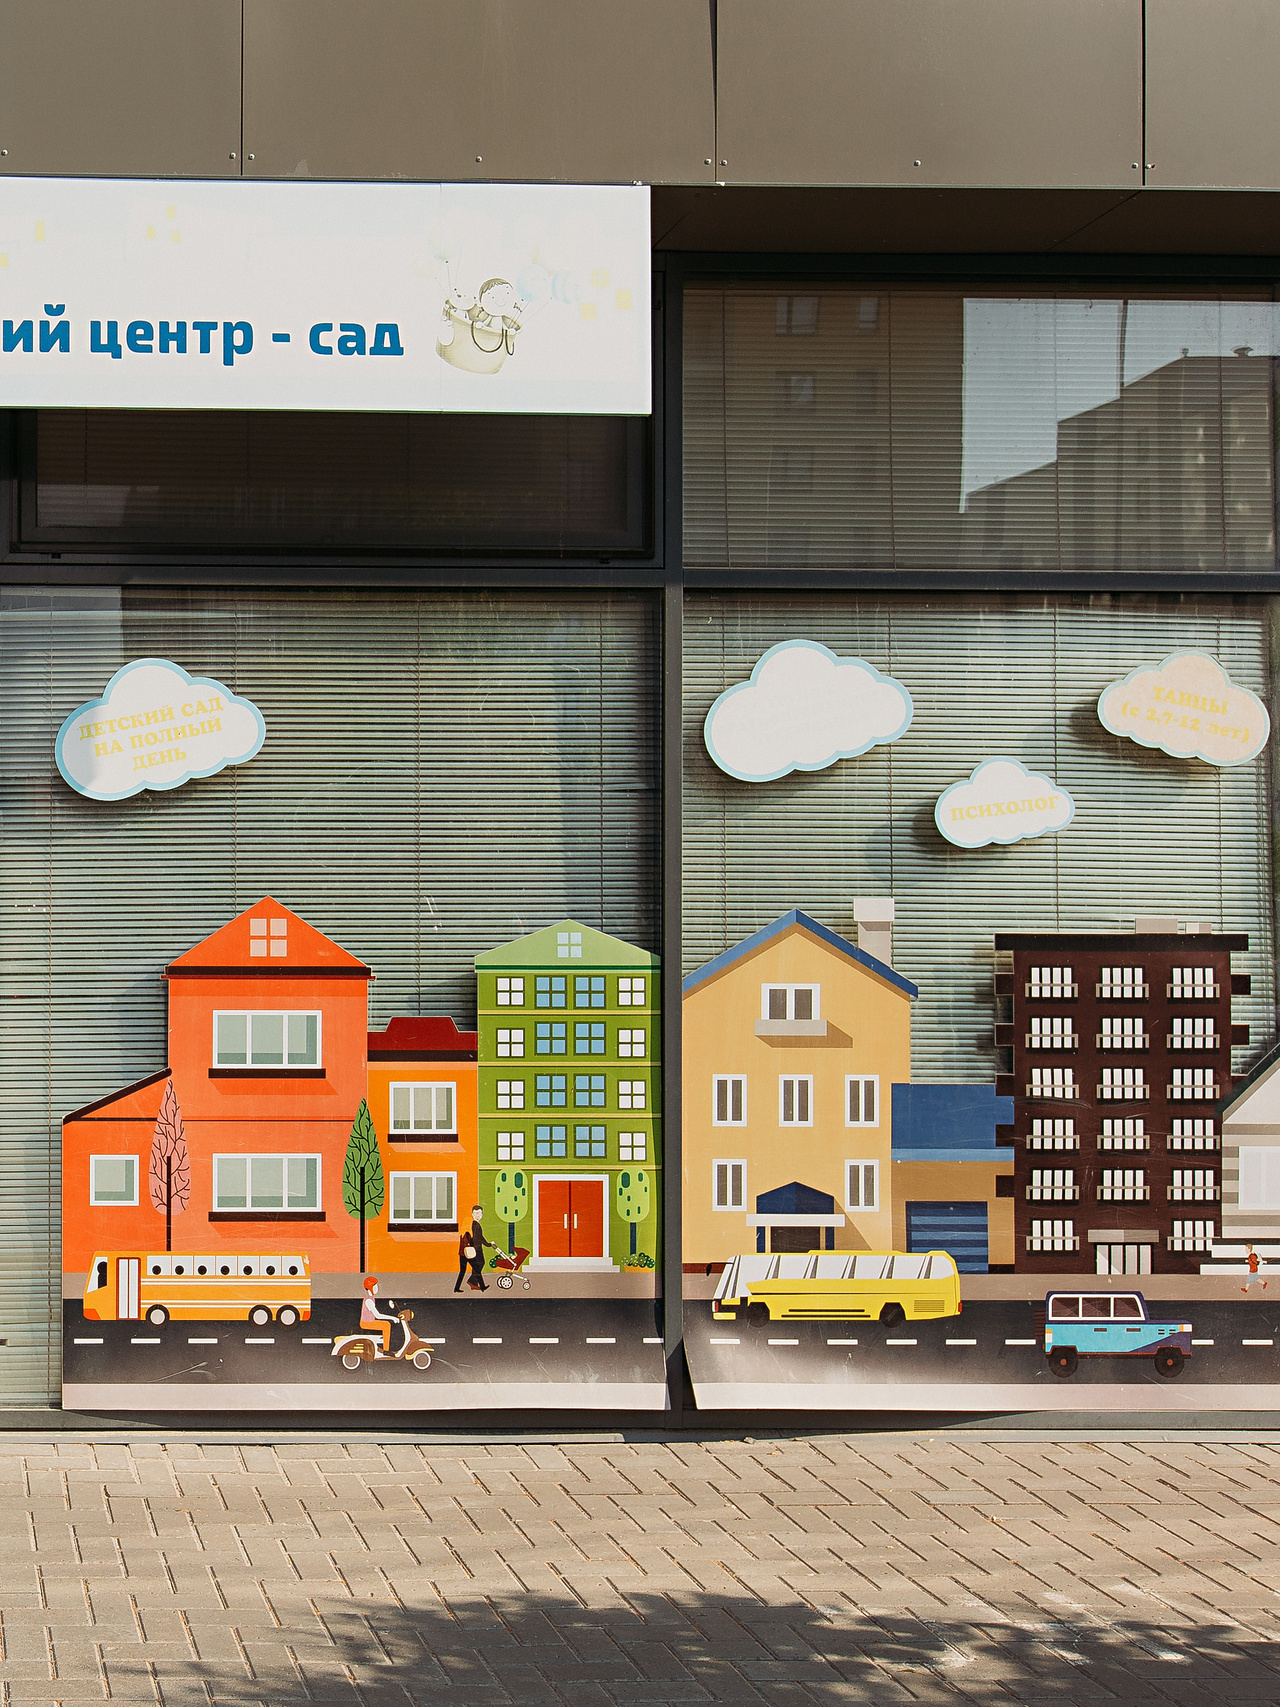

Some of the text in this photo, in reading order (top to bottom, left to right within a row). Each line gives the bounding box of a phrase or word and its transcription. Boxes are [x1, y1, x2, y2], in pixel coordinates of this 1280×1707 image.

[90, 320, 255, 366] центр
[308, 320, 405, 357] сад
[1153, 685, 1228, 715] ТАНЦЫ
[79, 697, 224, 741] ДЕТСКИЙ САД
[94, 716, 223, 757] НА ПОЛНЫЙ
[1146, 708, 1200, 733] 2,7-12
[1206, 722, 1250, 744] лет)
[133, 747, 187, 772] ДЕНЬ
[951, 795, 1059, 821] ПСИХОЛОГ
